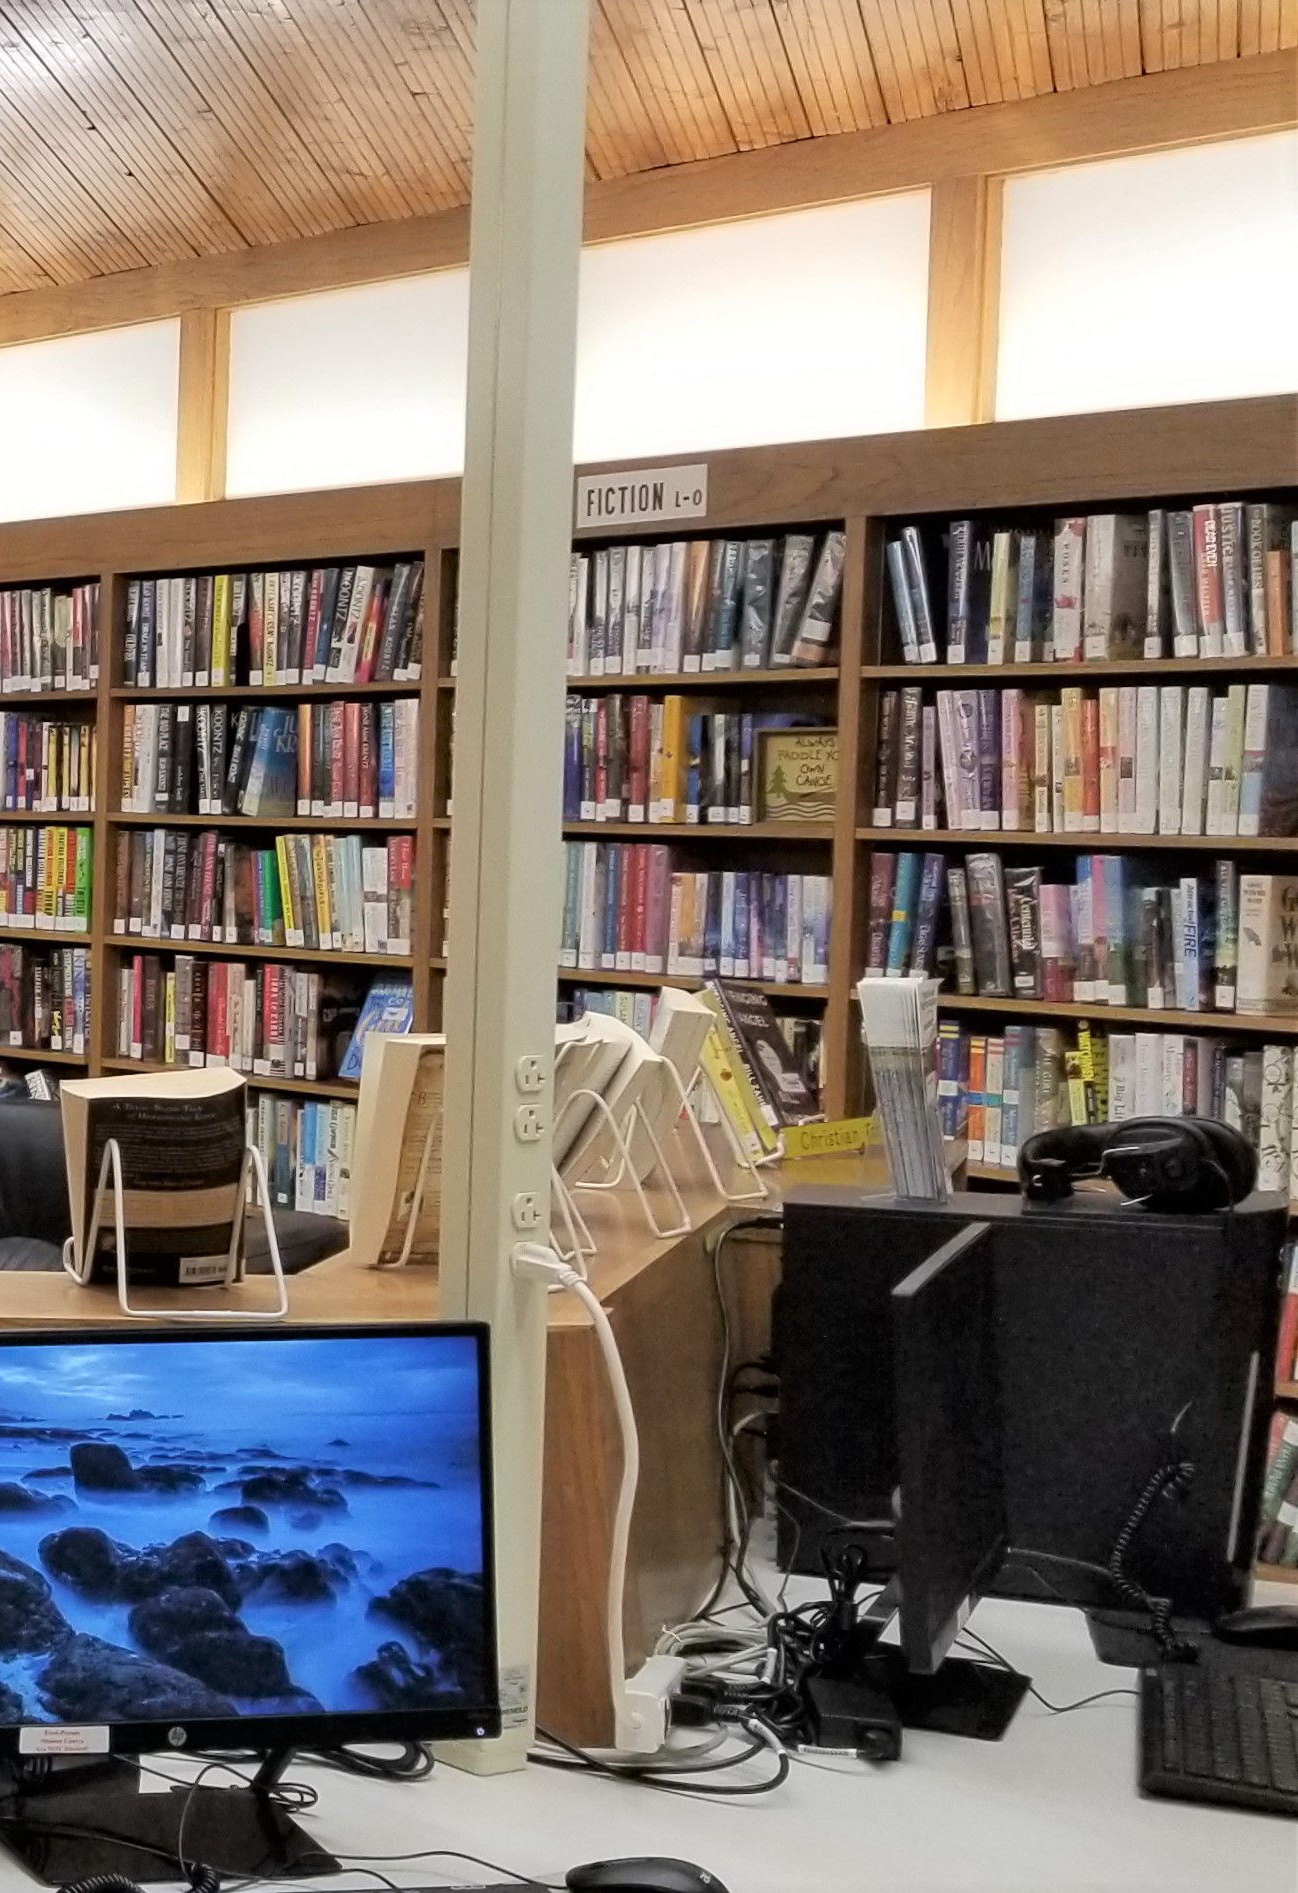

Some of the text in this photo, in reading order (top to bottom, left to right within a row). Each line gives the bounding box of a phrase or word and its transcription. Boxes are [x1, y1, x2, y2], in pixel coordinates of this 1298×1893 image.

[587, 482, 664, 517] FICTION
[826, 750, 839, 761] YO
[1184, 924, 1196, 957] FIRE
